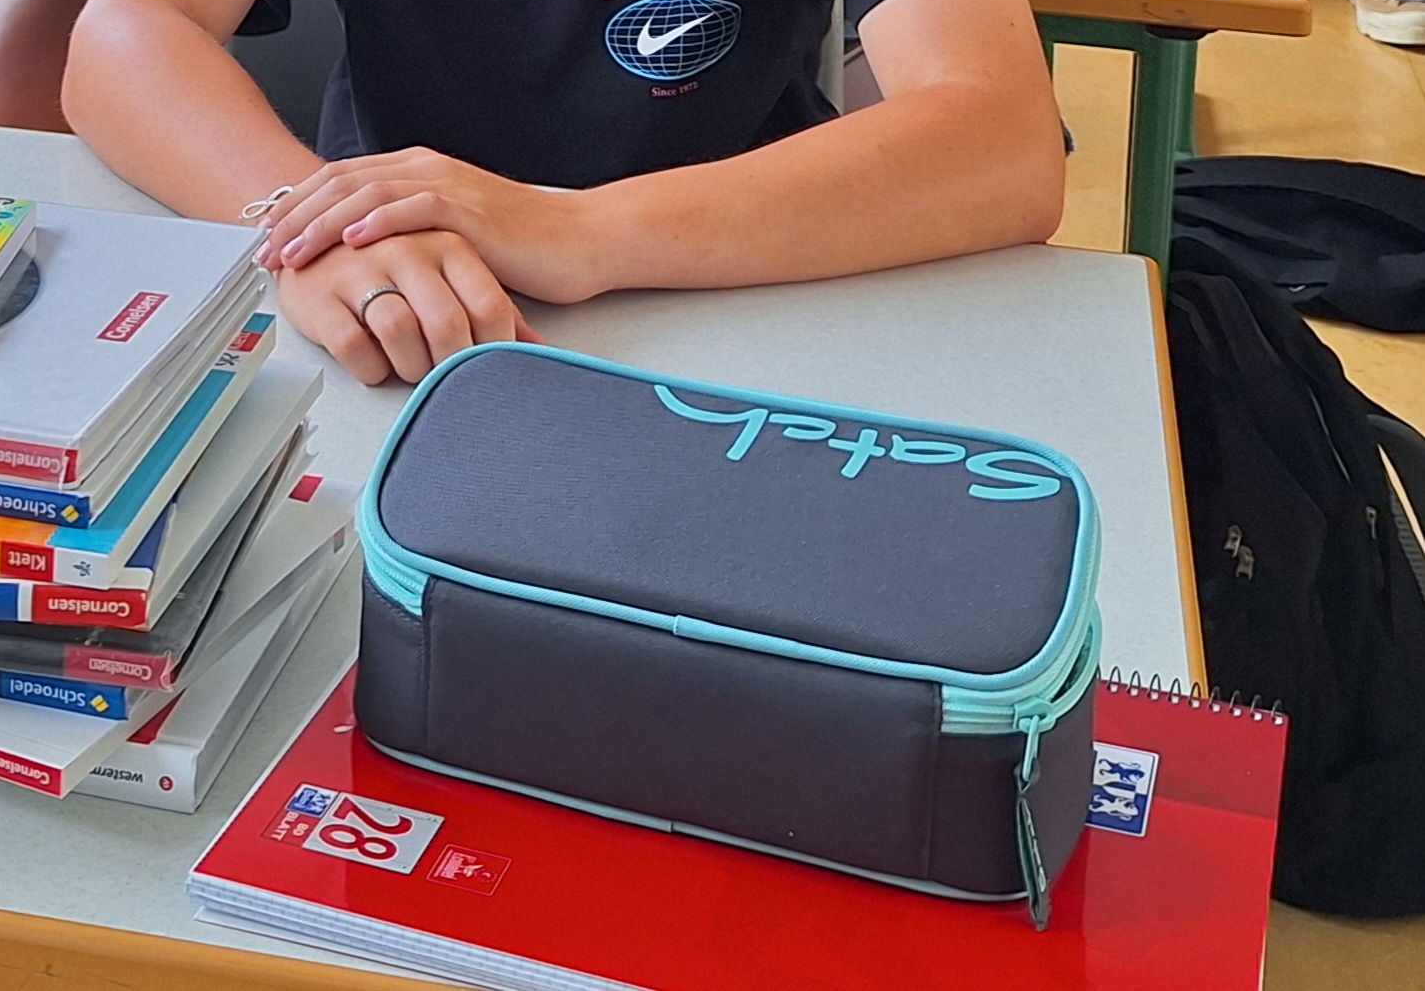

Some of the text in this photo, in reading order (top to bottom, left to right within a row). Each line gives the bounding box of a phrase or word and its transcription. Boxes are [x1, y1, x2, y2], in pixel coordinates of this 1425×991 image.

[651, 85, 676, 97] Since
[107, 293, 159, 341] Cornelsen
[8, 551, 46, 572] Klett
[48, 596, 131, 618] Cornelsen
[88, 657, 153, 681] Cornelsen
[9, 678, 86, 707] Schroedel
[271, 811, 300, 841] BLATT
[292, 822, 310, 837] 80
[318, 796, 415, 861] 28
